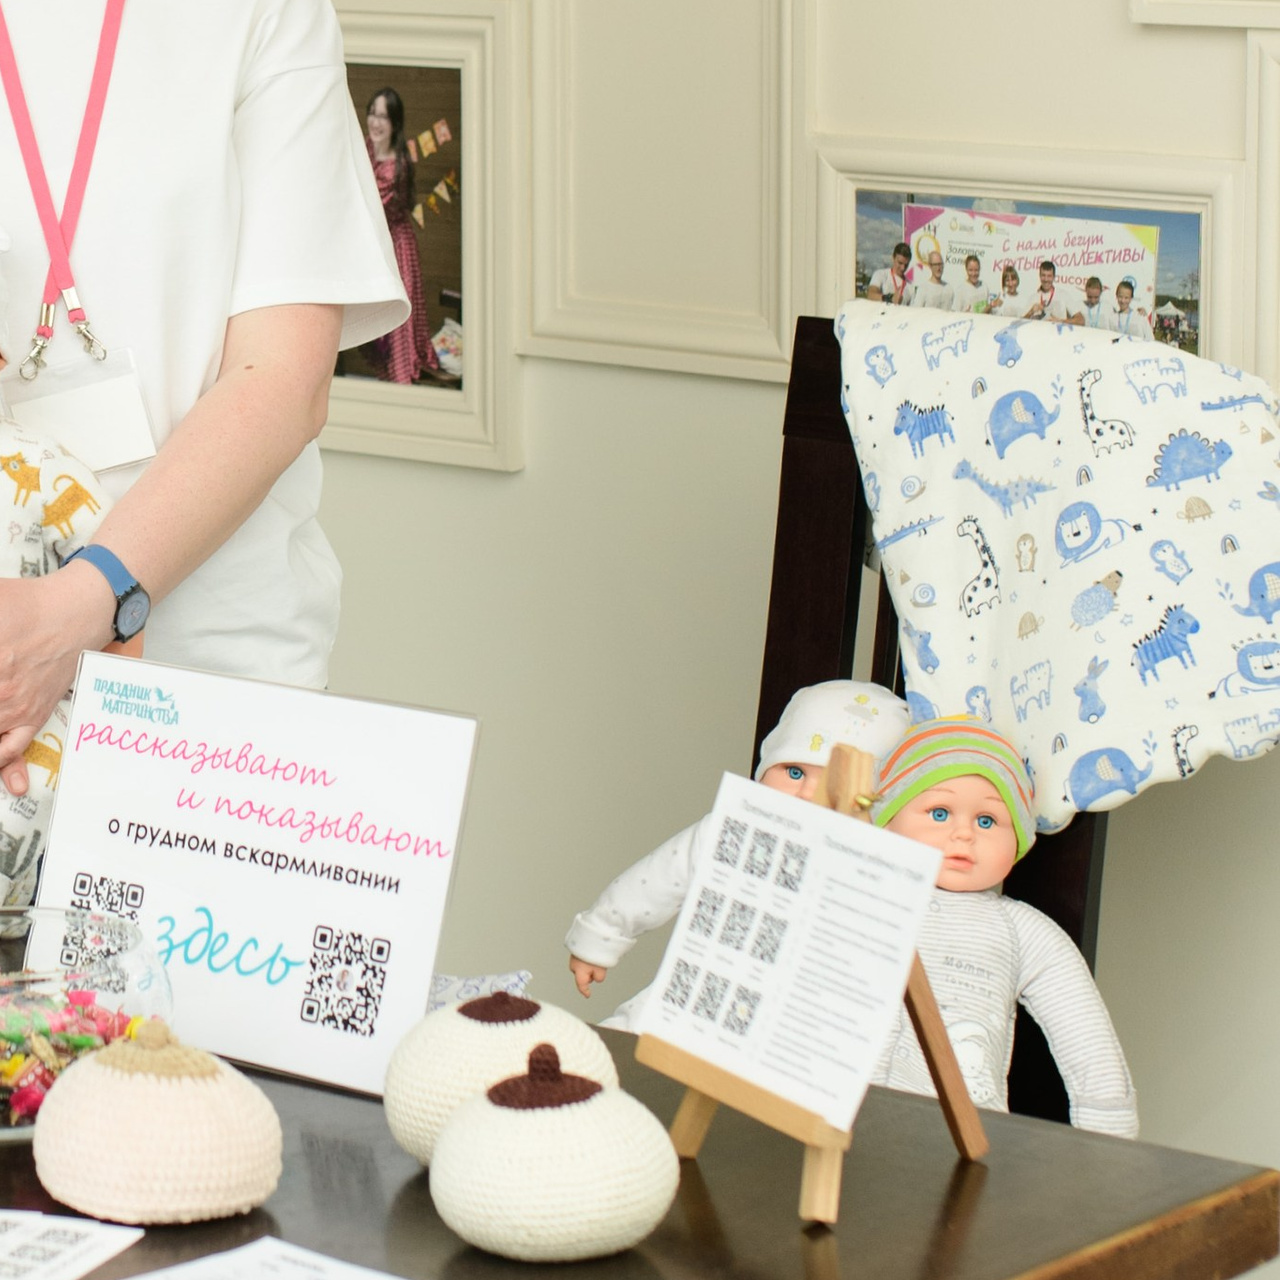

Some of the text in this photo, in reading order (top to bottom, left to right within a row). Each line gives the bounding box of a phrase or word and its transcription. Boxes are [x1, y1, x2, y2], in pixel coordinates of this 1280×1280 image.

[1002, 238, 1010, 252] С
[1016, 238, 1057, 252] нами
[1063, 229, 1104, 254] бегут
[1050, 247, 1146, 268] КОЛЛЕКТИВЫ
[93, 677, 152, 702] ПРАЗДНИК
[101, 695, 179, 726] МАТЕРИНСТВА
[75, 721, 338, 788] рассказывают
[175, 786, 452, 859] и показывают
[107, 817, 401, 894] о грудном вскармливании
[156, 906, 305, 986] здесь
